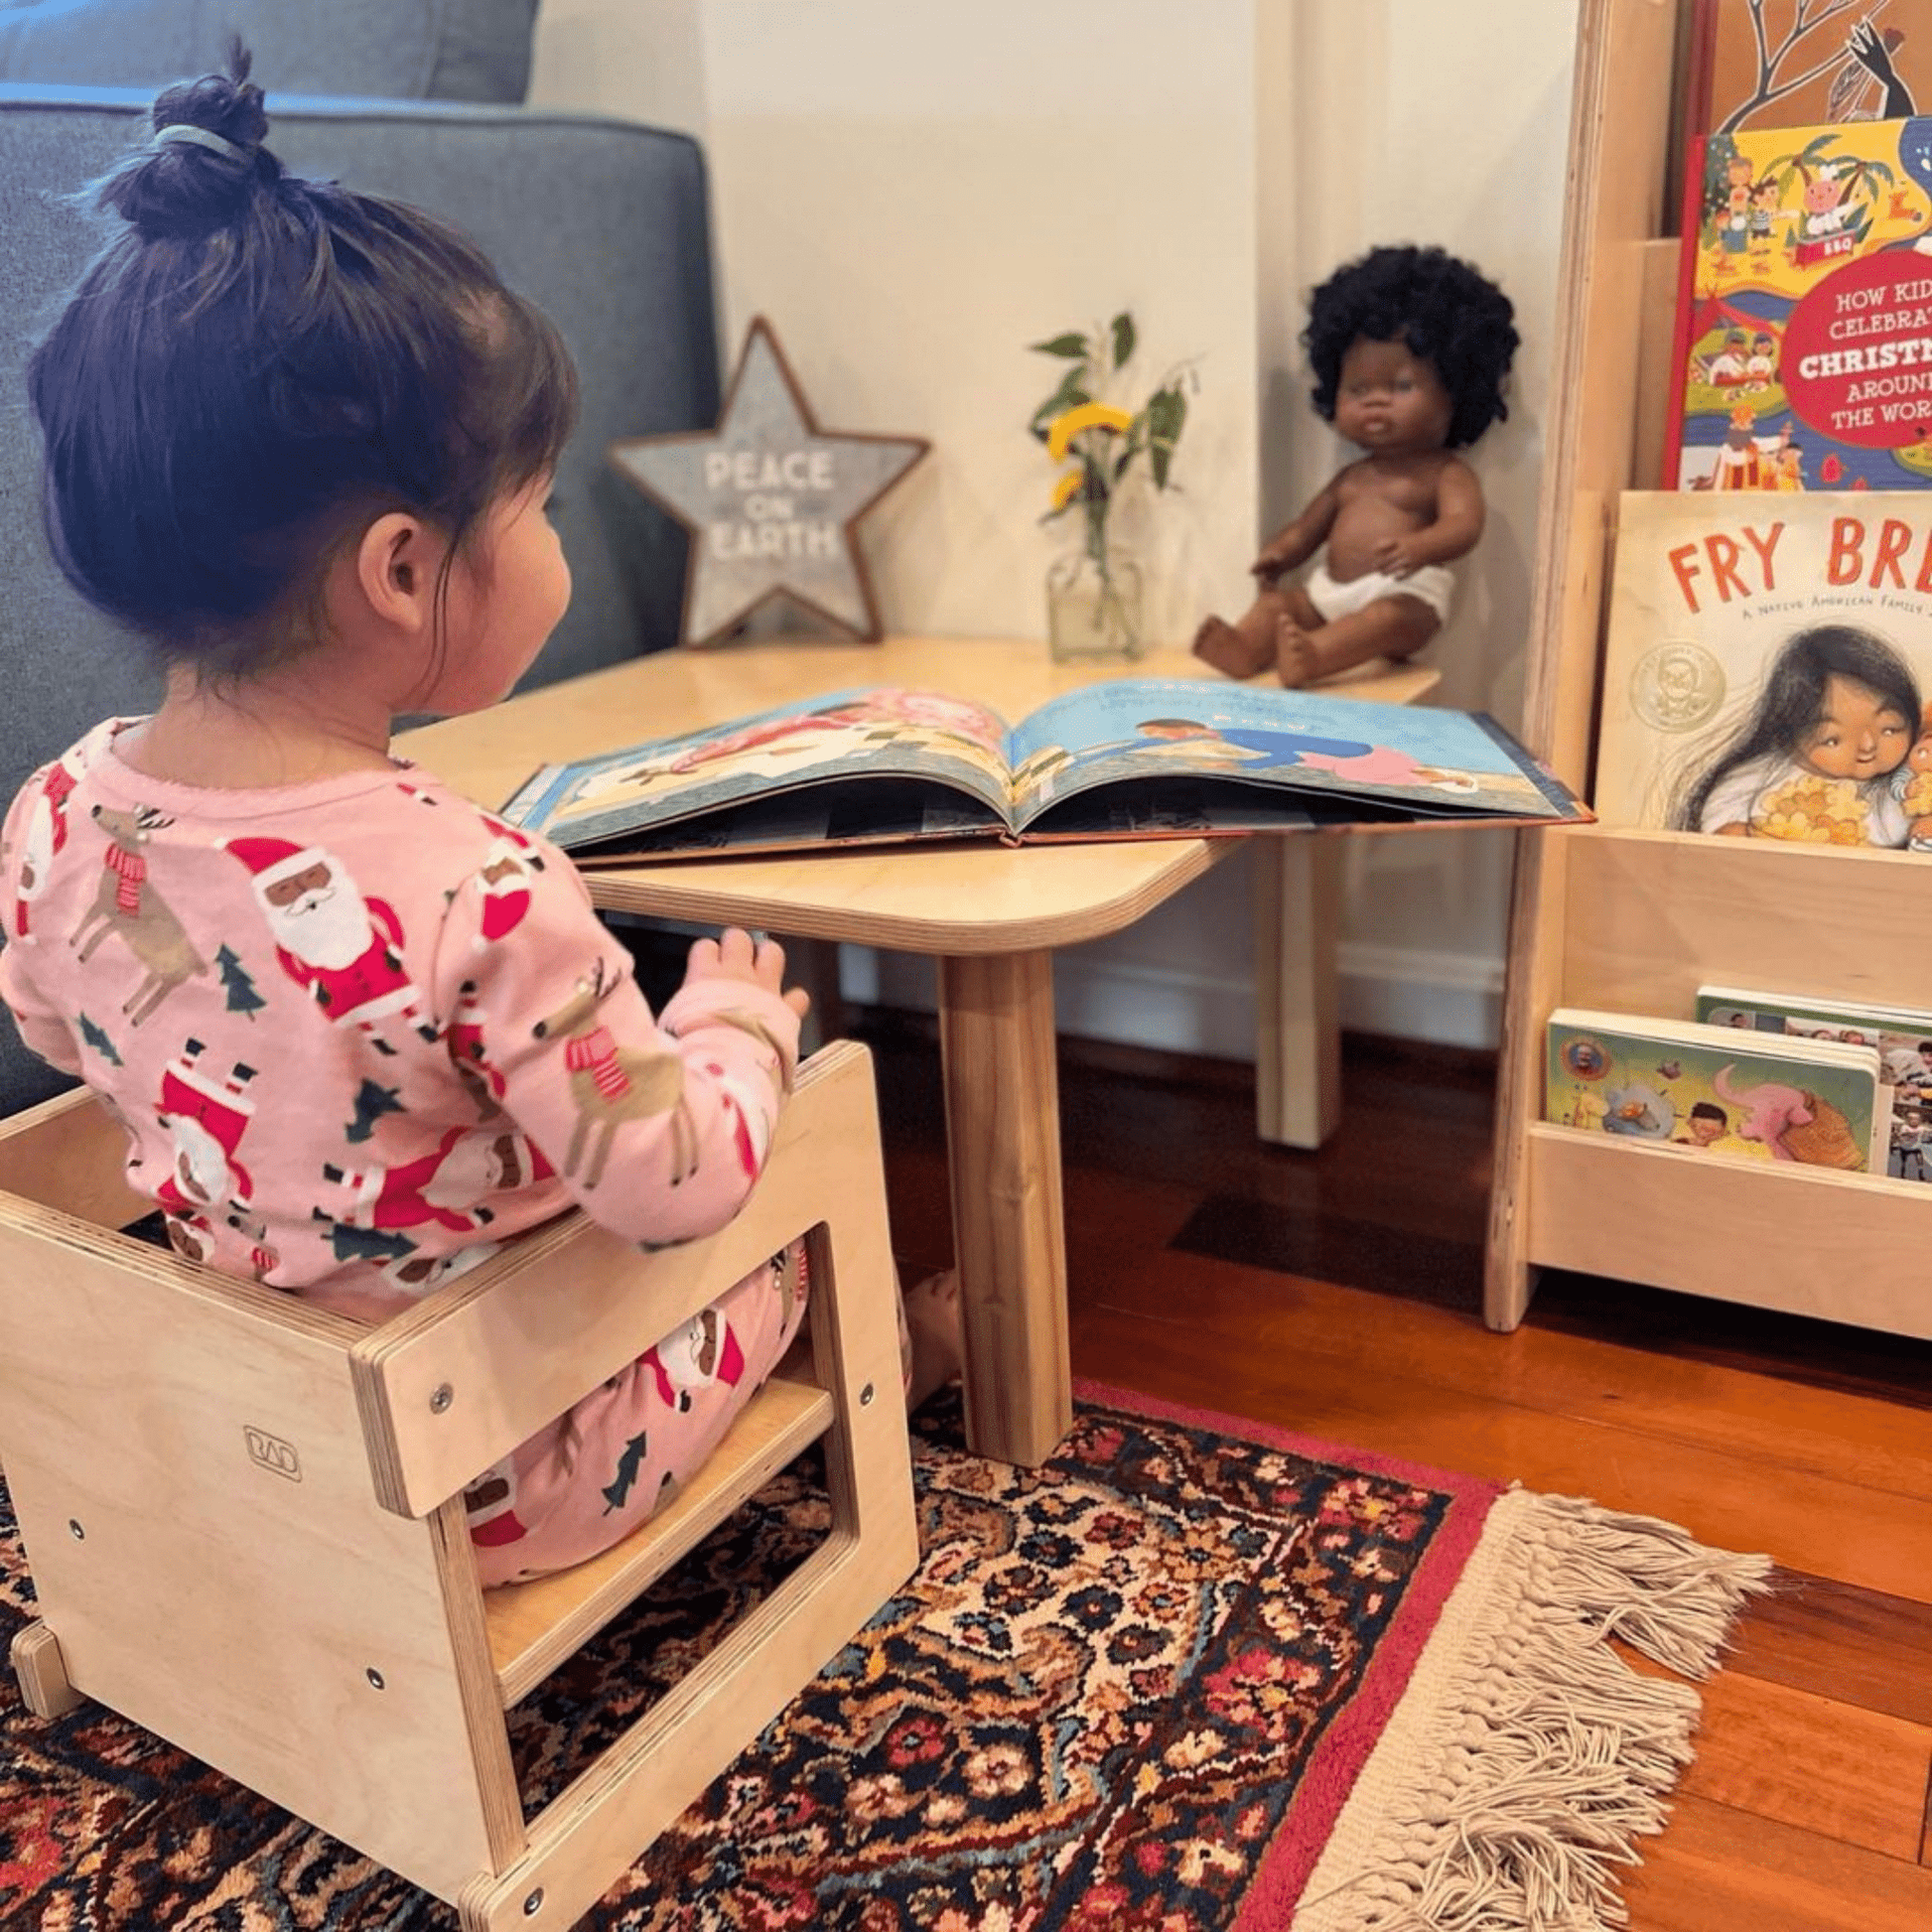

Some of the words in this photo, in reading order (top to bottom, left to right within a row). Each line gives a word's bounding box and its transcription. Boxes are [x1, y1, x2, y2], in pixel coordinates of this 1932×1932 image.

[1836, 286, 1886, 313] HOW
[1831, 406, 1874, 430] THE
[705, 452, 834, 489] PEACE
[746, 495, 794, 520] ON
[709, 522, 838, 560] EARTH
[1668, 521, 1786, 615] FRY
